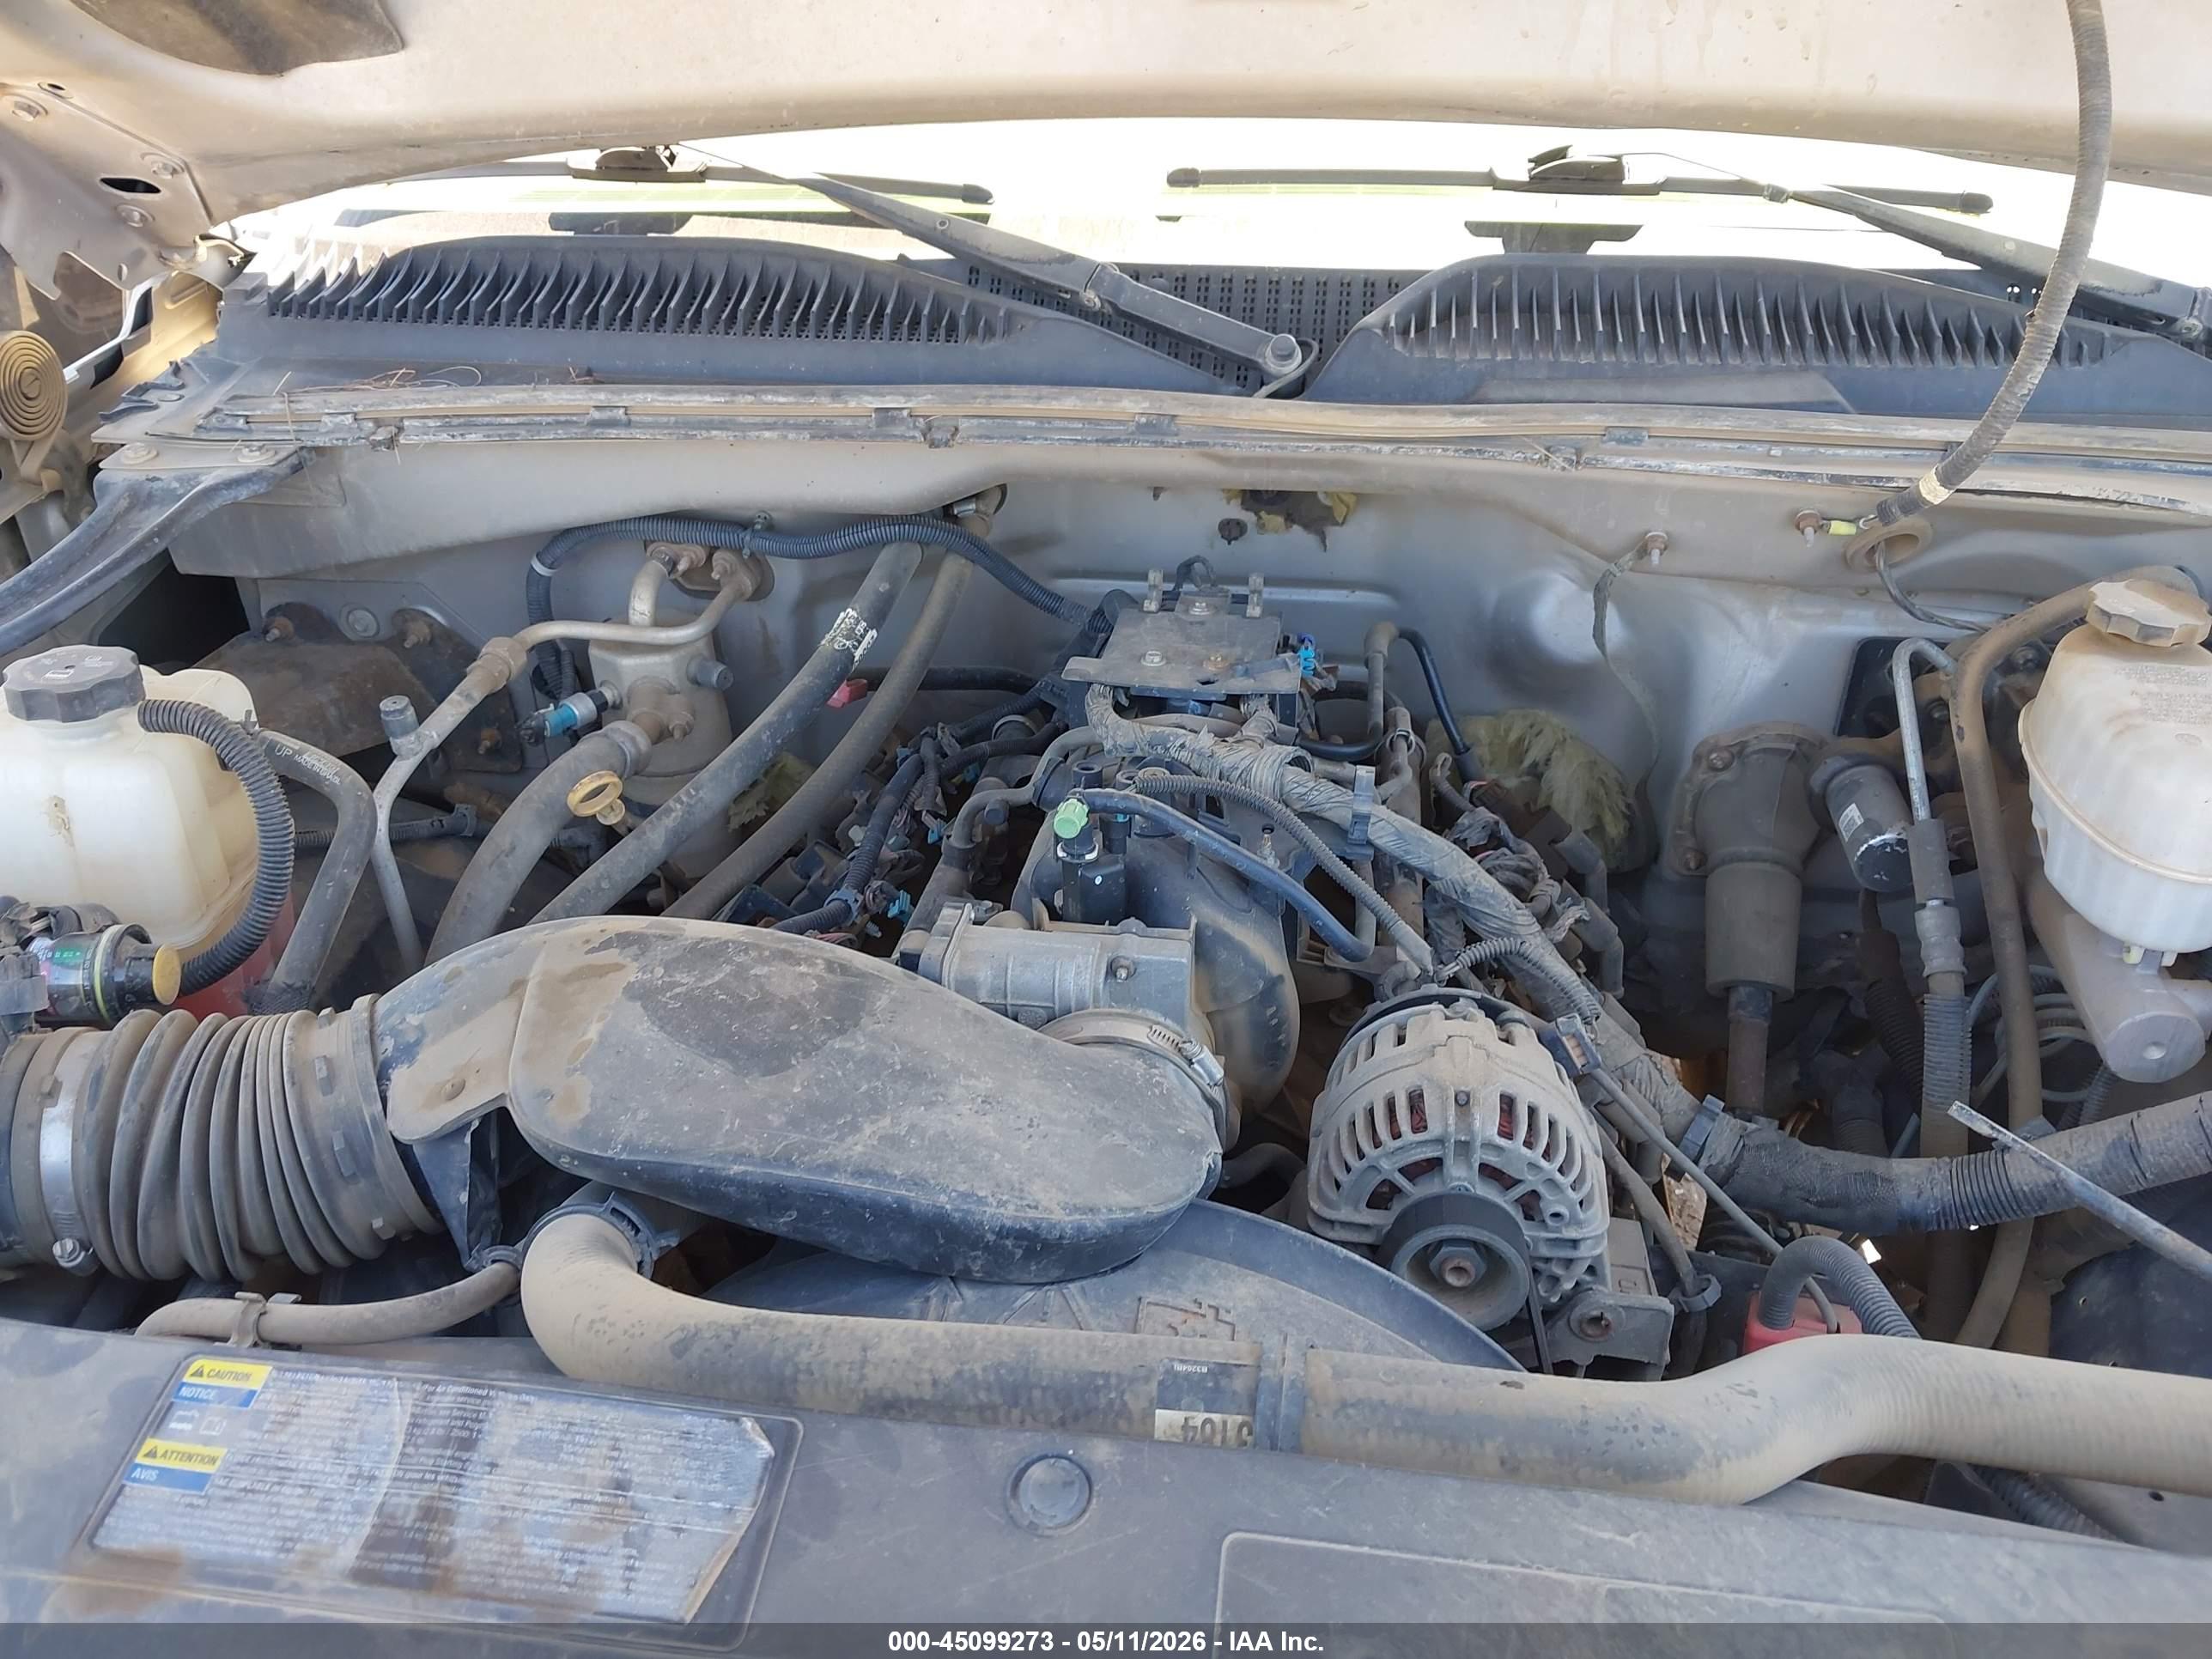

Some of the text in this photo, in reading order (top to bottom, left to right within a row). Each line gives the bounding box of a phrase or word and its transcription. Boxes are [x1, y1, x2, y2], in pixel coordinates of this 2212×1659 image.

[275, 744, 293, 757] UP
[206, 1367, 252, 1382] CAUTION
[179, 1385, 217, 1400] NOTICE
[159, 1449, 220, 1467] ATTENTION
[131, 1468, 160, 1481] AVIS
